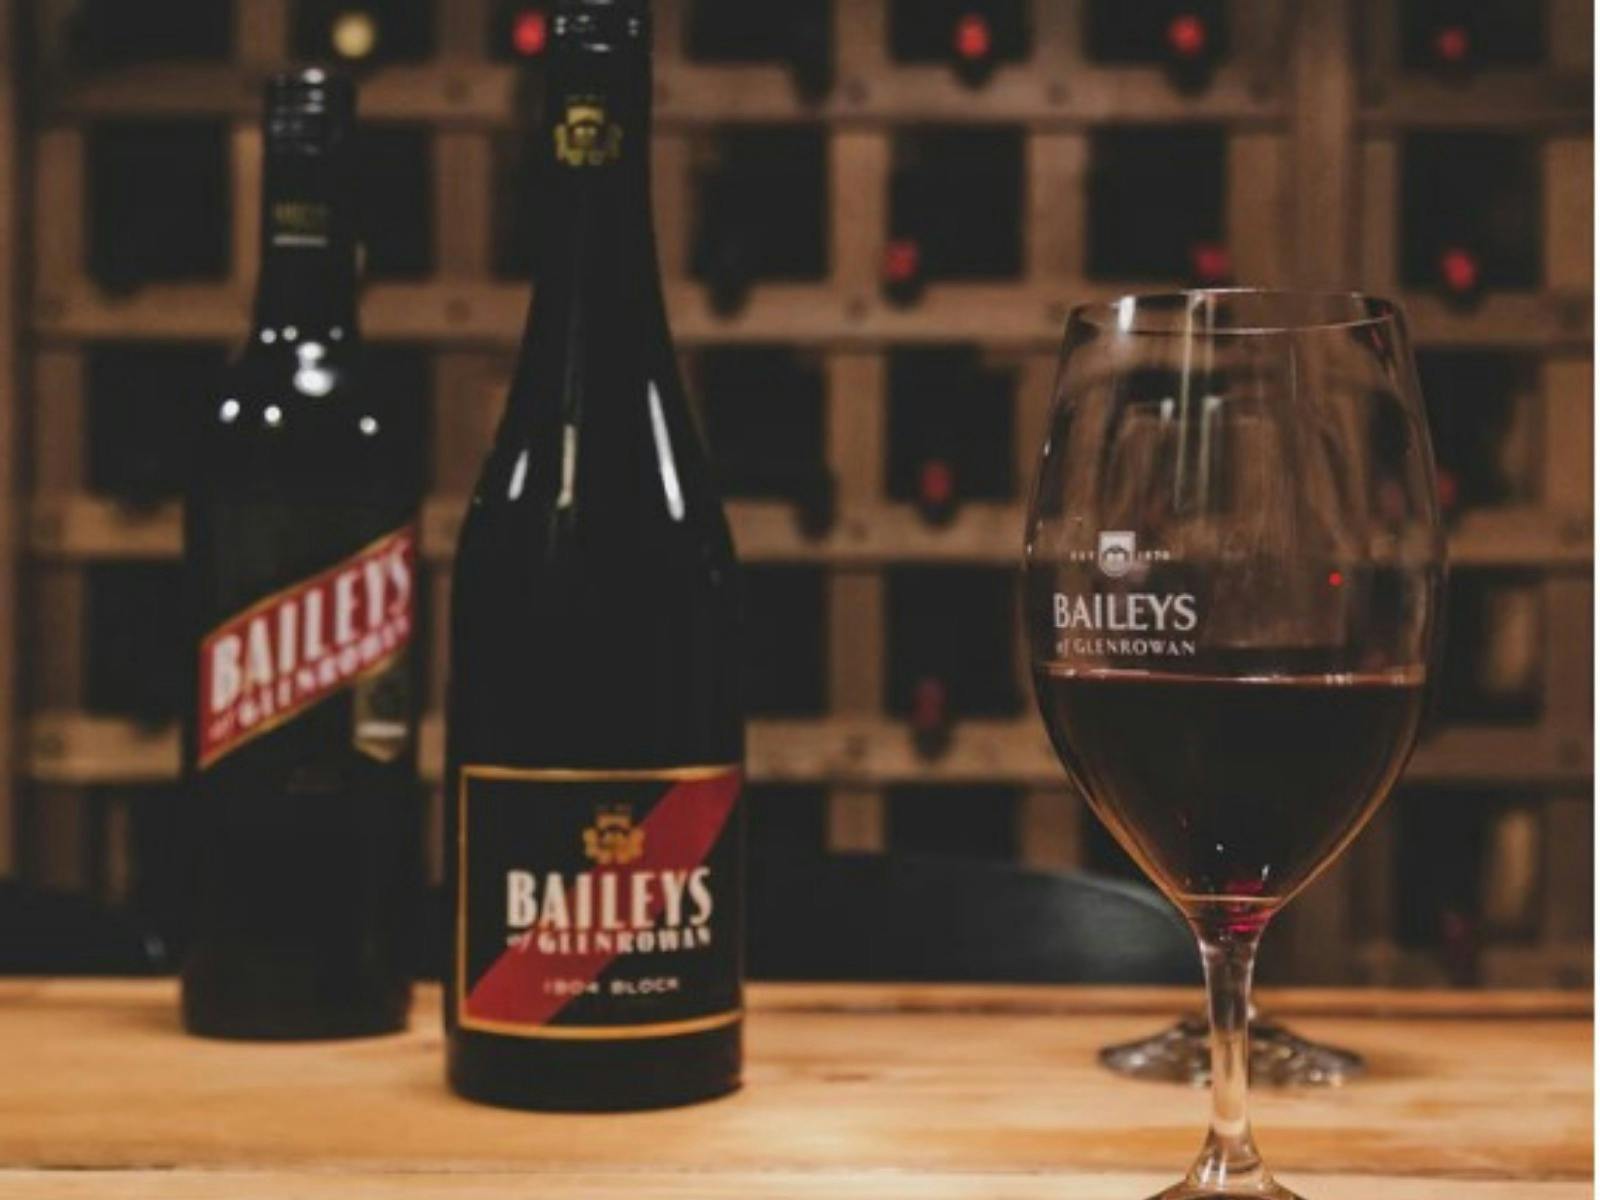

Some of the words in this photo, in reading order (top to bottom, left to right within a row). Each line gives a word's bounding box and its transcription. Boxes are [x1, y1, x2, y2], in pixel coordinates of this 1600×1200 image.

[1053, 592, 1198, 632] BAILEYS
[1072, 637, 1197, 657] GLENROWAN
[506, 866, 713, 931] BAILEYS
[537, 926, 712, 955] GLENROWAN
[610, 976, 680, 996] BLOCK
